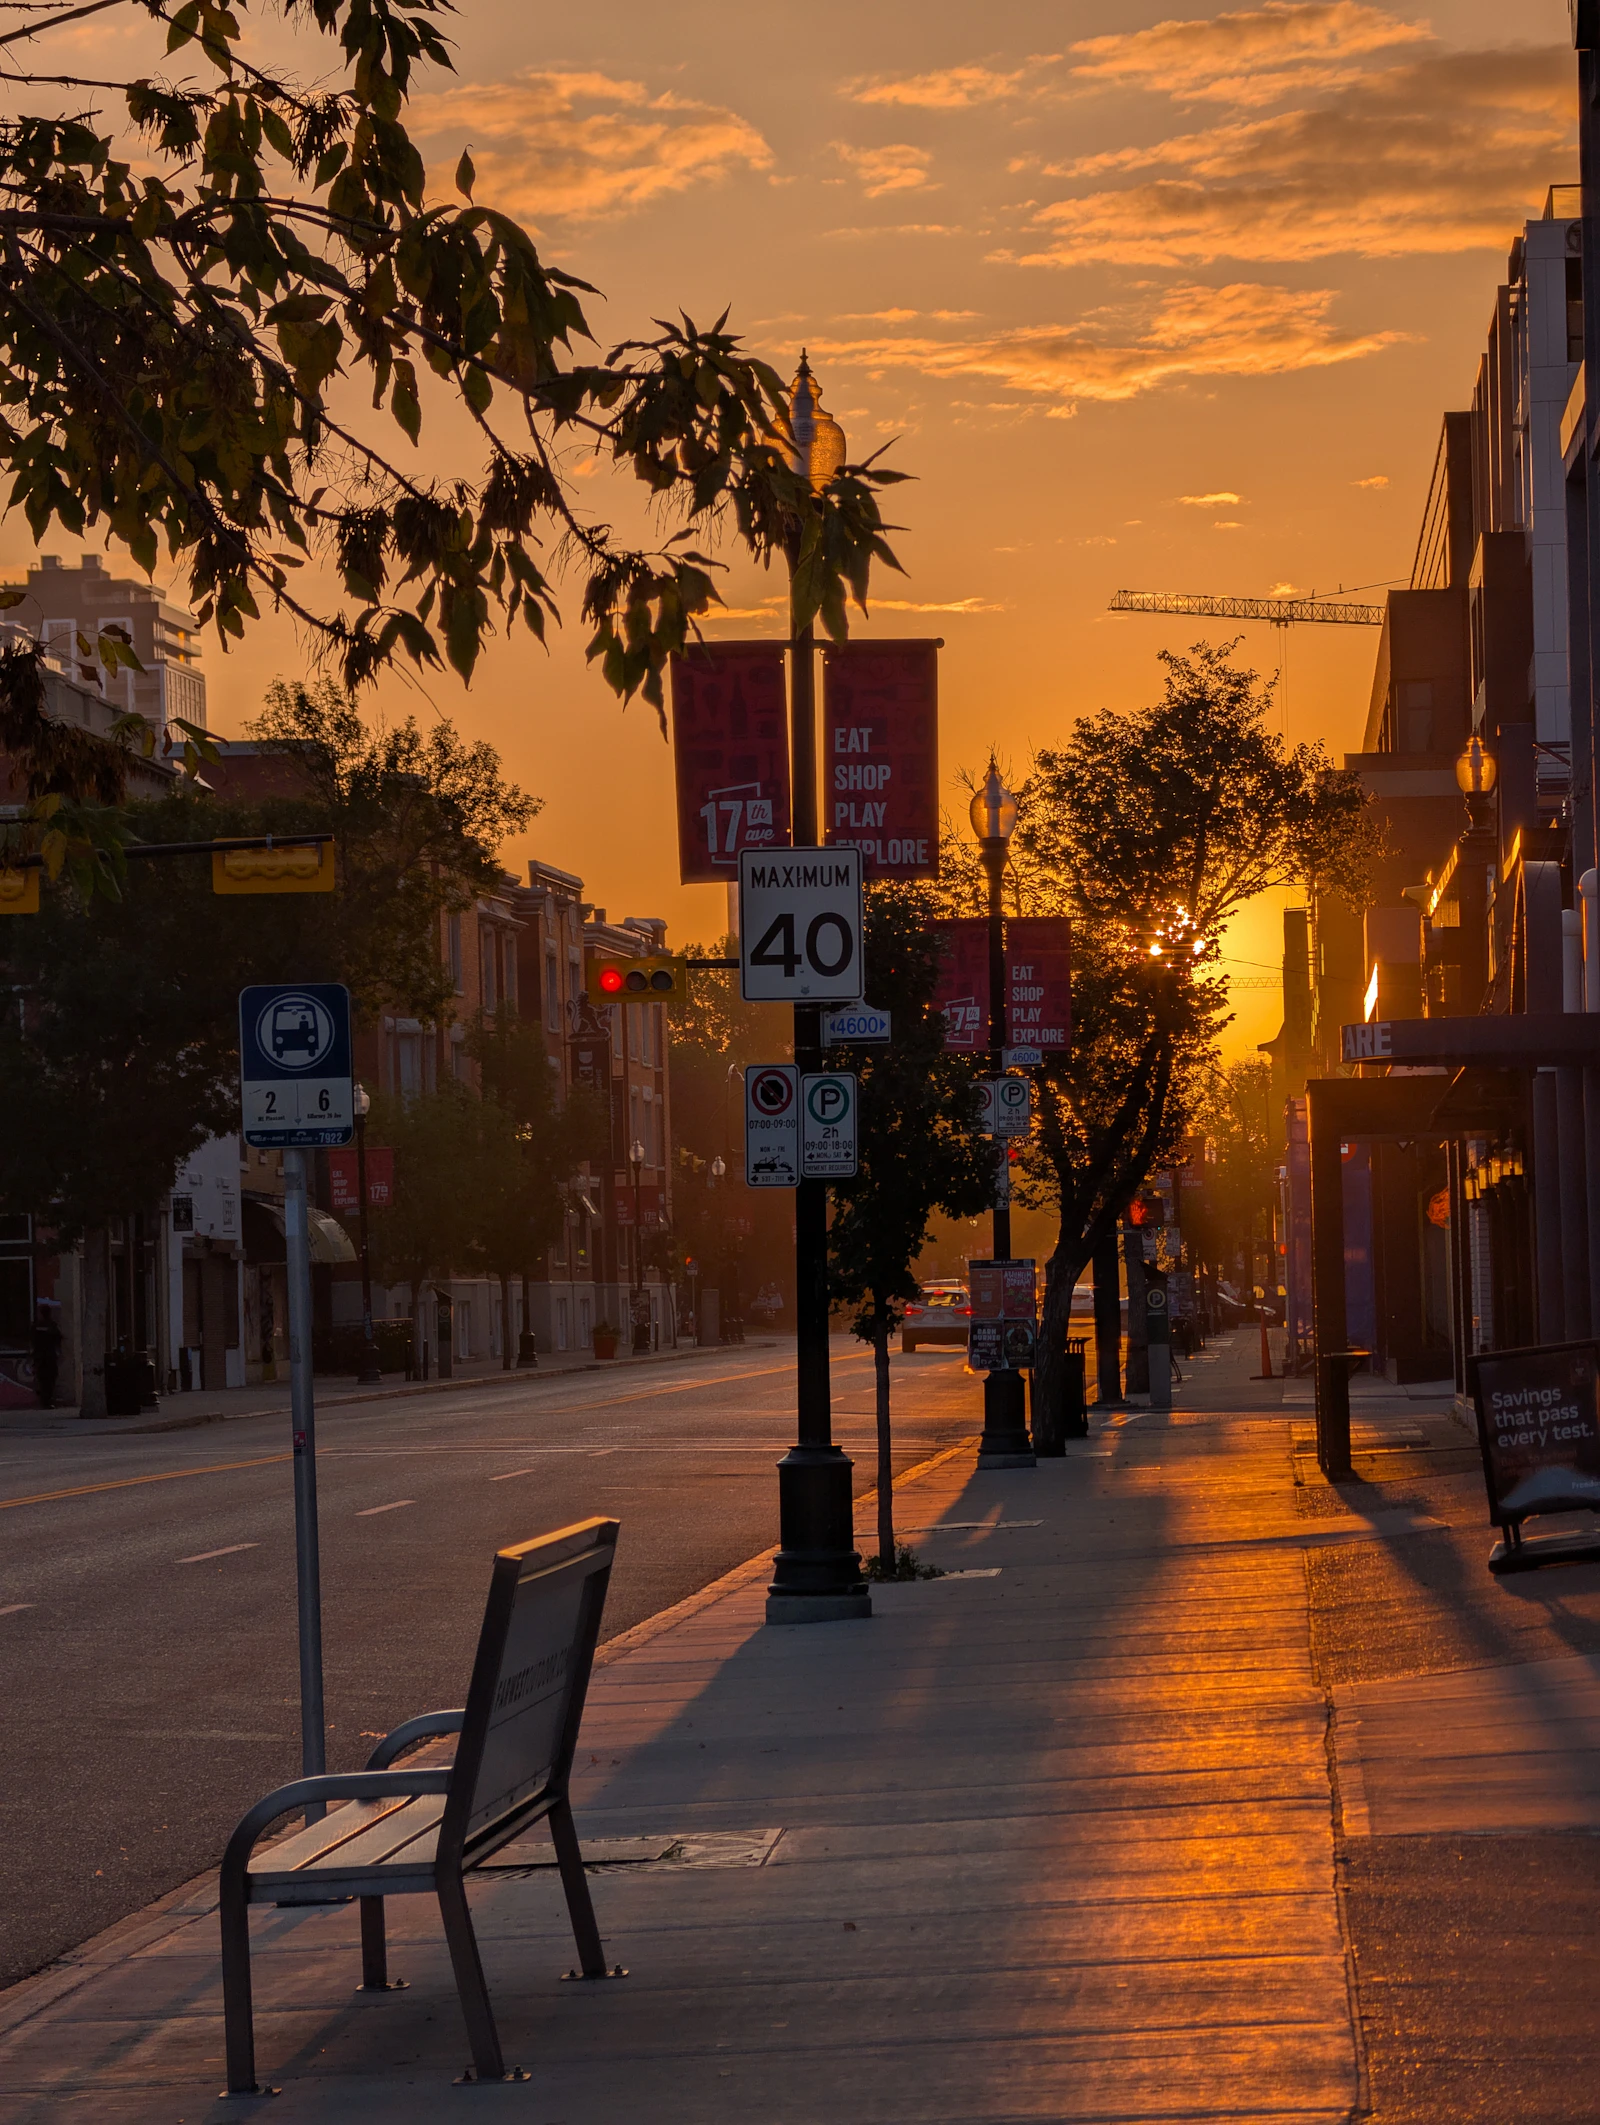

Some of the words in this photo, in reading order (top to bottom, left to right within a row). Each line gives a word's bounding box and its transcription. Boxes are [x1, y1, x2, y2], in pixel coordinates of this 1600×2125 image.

[834, 727, 873, 753] EAT
[834, 764, 892, 791] SHOP
[835, 801, 887, 828] PLAY
[745, 828, 775, 841] ave
[835, 838, 929, 865] PLORE
[751, 865, 850, 889] MAXIMUM
[750, 911, 854, 977] 40
[1012, 965, 1034, 981] EAT
[1012, 986, 1044, 1002] SHOP
[836, 1016, 879, 1035] 4600
[1012, 1007, 1042, 1023] PLAY
[1012, 1028, 1065, 1043] EXPLORE
[1011, 1052, 1036, 1063] 4600
[265, 1091, 277, 1113] 2
[318, 1089, 330, 1111] 6
[749, 1119, 796, 1129] 07:00-09:00
[319, 1132, 343, 1144] 7922
[1491, 1388, 1562, 1409] Savings
[1495, 1408, 1534, 1429] that
[1538, 1405, 1579, 1427] pass
[1497, 1429, 1548, 1448] every
[1552, 1422, 1594, 1441] test.
